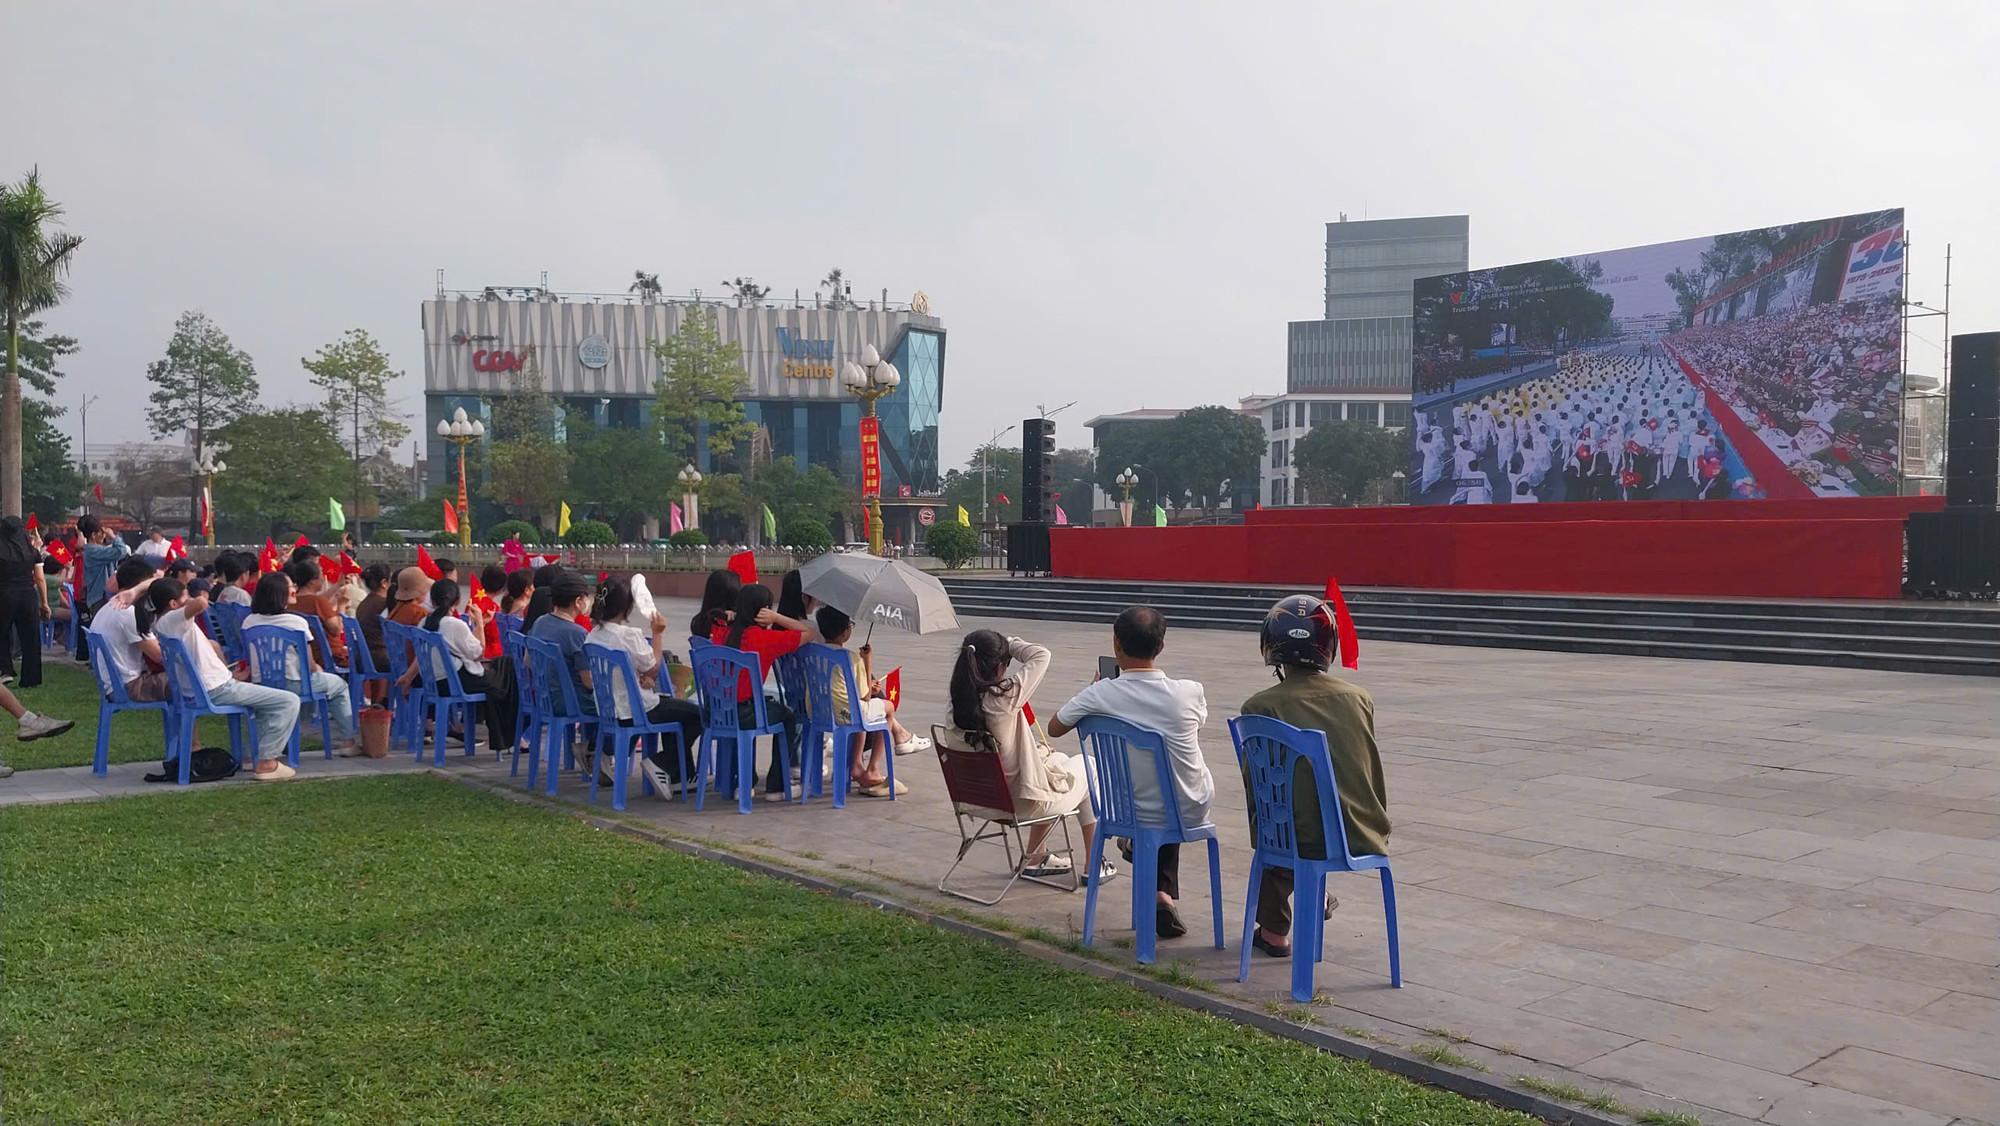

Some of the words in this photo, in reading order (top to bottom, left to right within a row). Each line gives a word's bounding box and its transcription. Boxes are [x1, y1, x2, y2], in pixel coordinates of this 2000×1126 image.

[1847, 263, 1902, 285] 1975-2025
[473, 349, 528, 372] CGV
[782, 361, 835, 379] Centre
[873, 603, 903, 621] AIA
